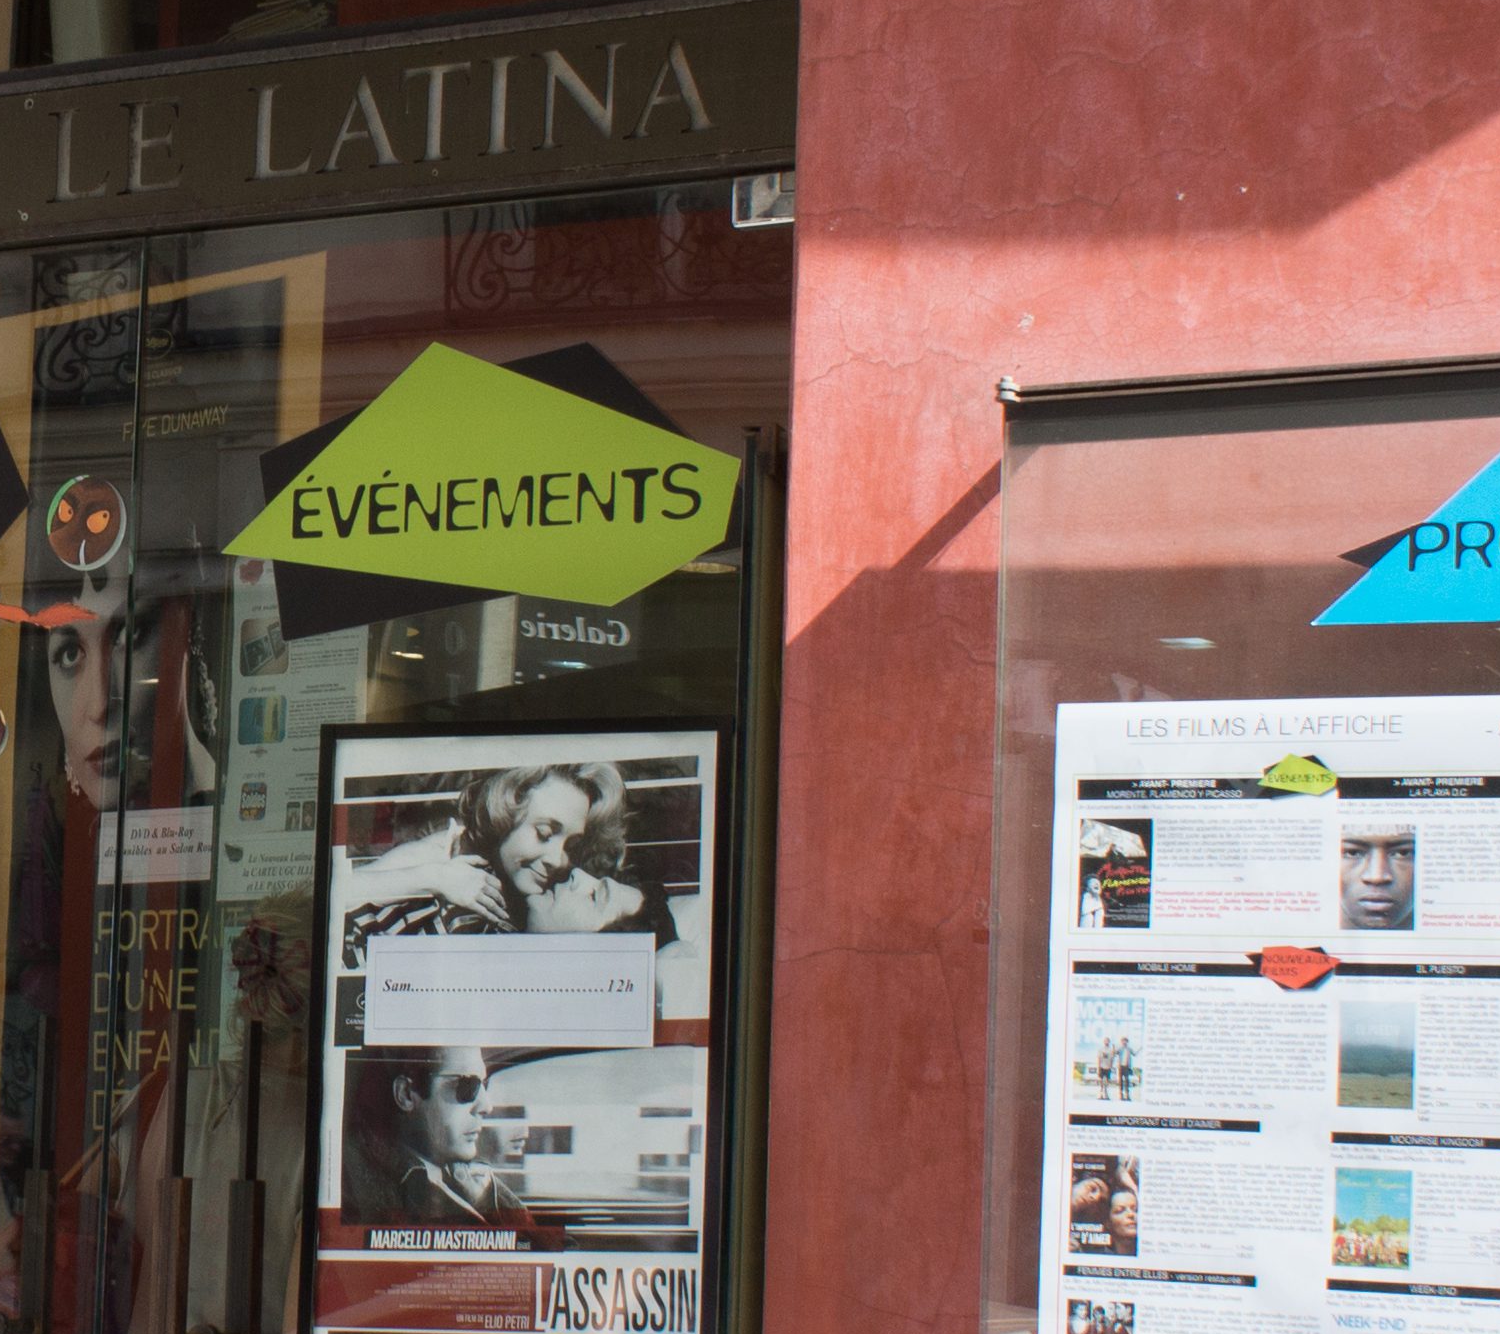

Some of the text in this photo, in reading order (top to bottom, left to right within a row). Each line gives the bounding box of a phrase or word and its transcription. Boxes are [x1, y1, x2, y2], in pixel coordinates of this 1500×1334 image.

[45, 35, 716, 205] LE LATINA
[161, 404, 229, 434] DUNAWAY
[291, 463, 702, 539] ÉVÉNEMENTS
[1126, 714, 1402, 738] LES FILMS À L'AFFICHE
[130, 826, 194, 840] DVD Blu-Ray
[94, 968, 198, 1013] D'UNE
[370, 1229, 516, 1251] MARCELLO MASTROIANNI
[534, 1266, 697, 1333] L'ASSASSIN
[484, 1315, 530, 1330] ELIO PETRI
